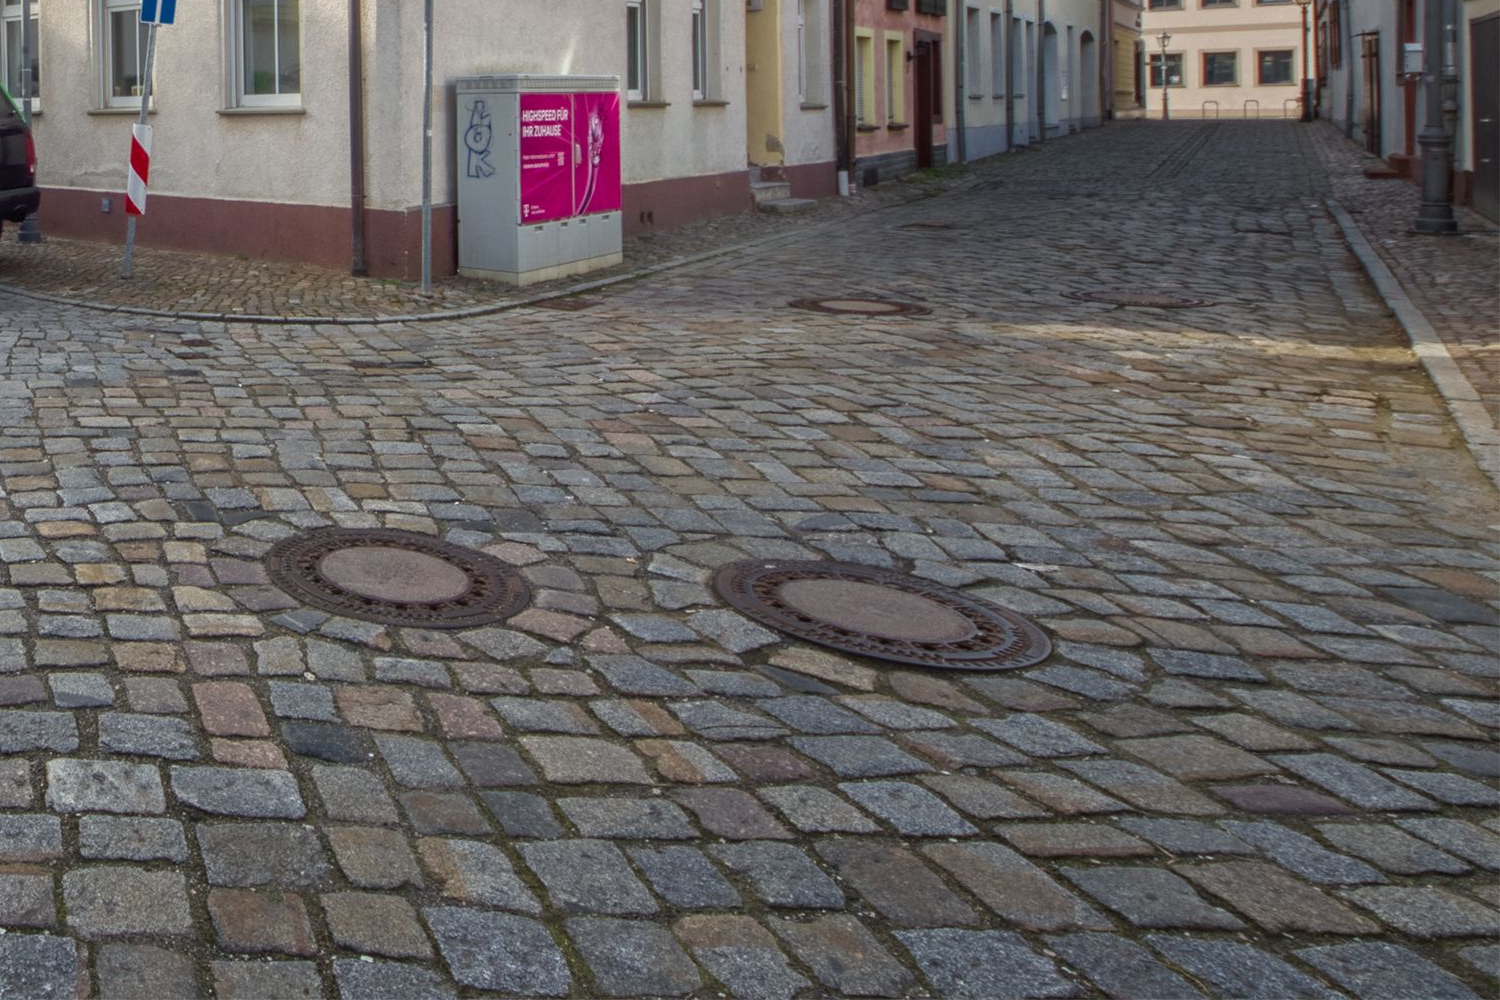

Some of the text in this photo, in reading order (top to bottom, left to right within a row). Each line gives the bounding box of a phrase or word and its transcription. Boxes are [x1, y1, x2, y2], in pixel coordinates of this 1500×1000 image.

[522, 106, 569, 122] HIGHSPEED FÜR
[522, 124, 562, 138] IHR ZUHAUSE
